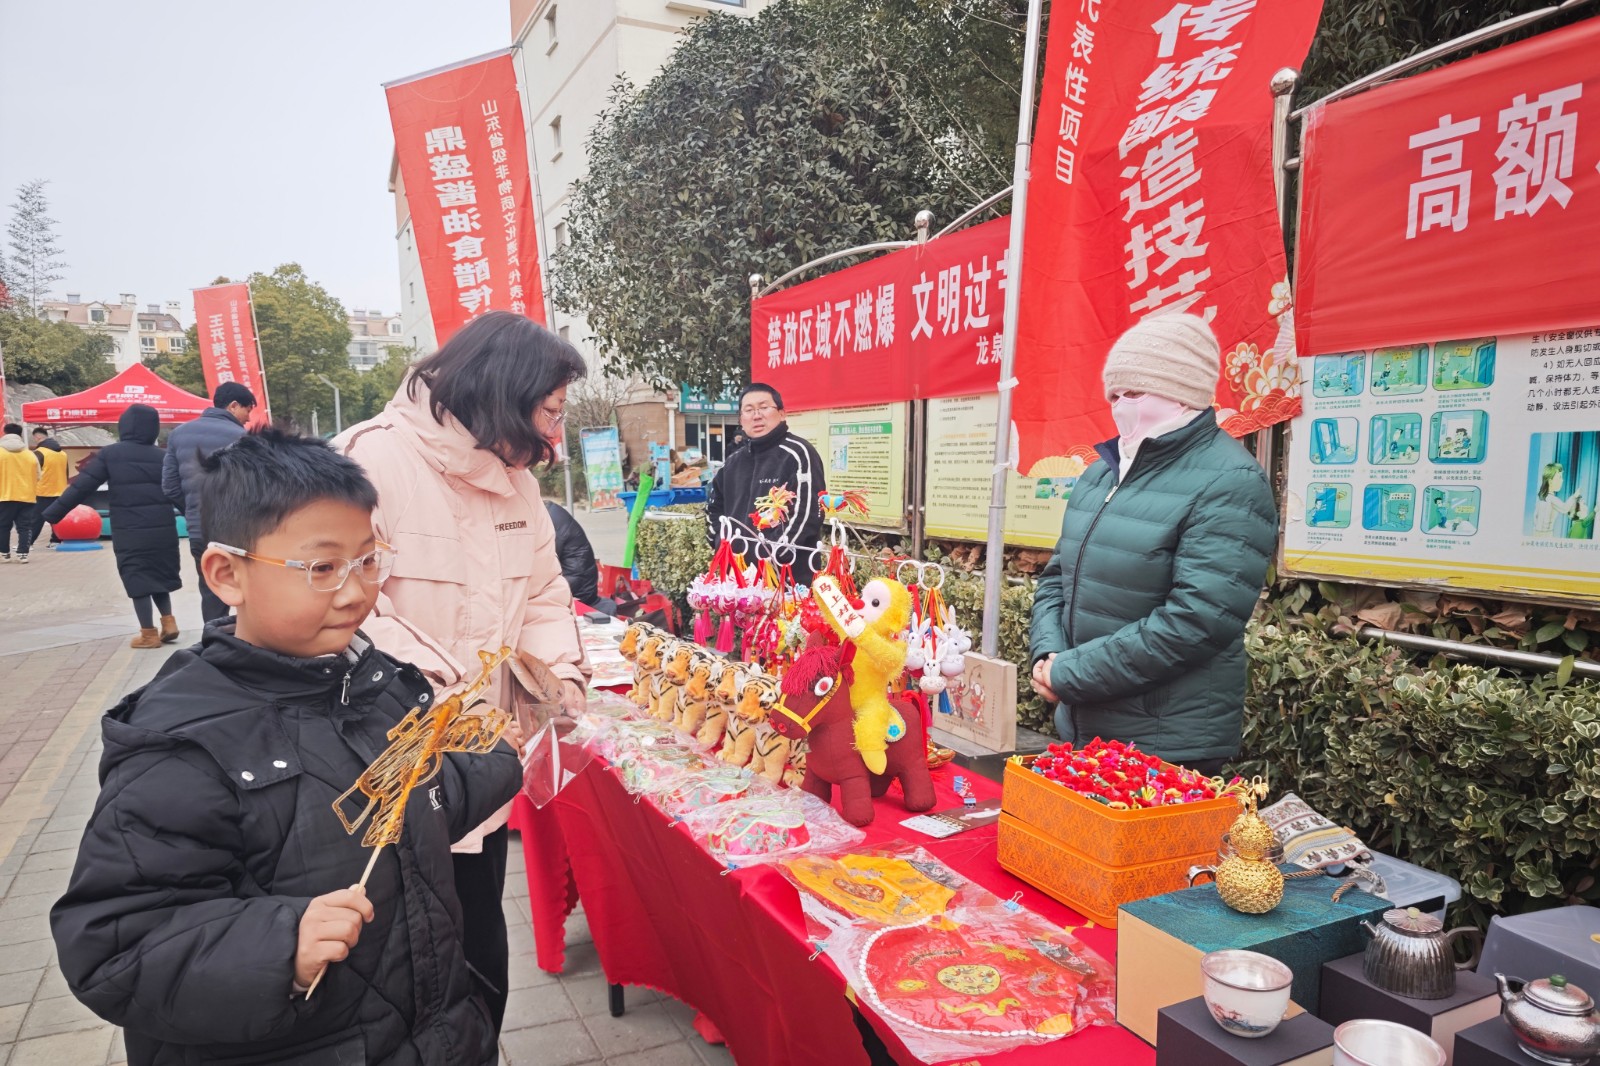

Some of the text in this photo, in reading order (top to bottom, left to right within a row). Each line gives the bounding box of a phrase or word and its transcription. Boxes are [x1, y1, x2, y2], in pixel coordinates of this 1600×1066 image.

[1405, 82, 1600, 240] 高额
[767, 282, 896, 369] 禁放区域不燃爆
[1527, 400, 1600, 412] 动静，设法引起外
[494, 520, 528, 532] FREEDOM
